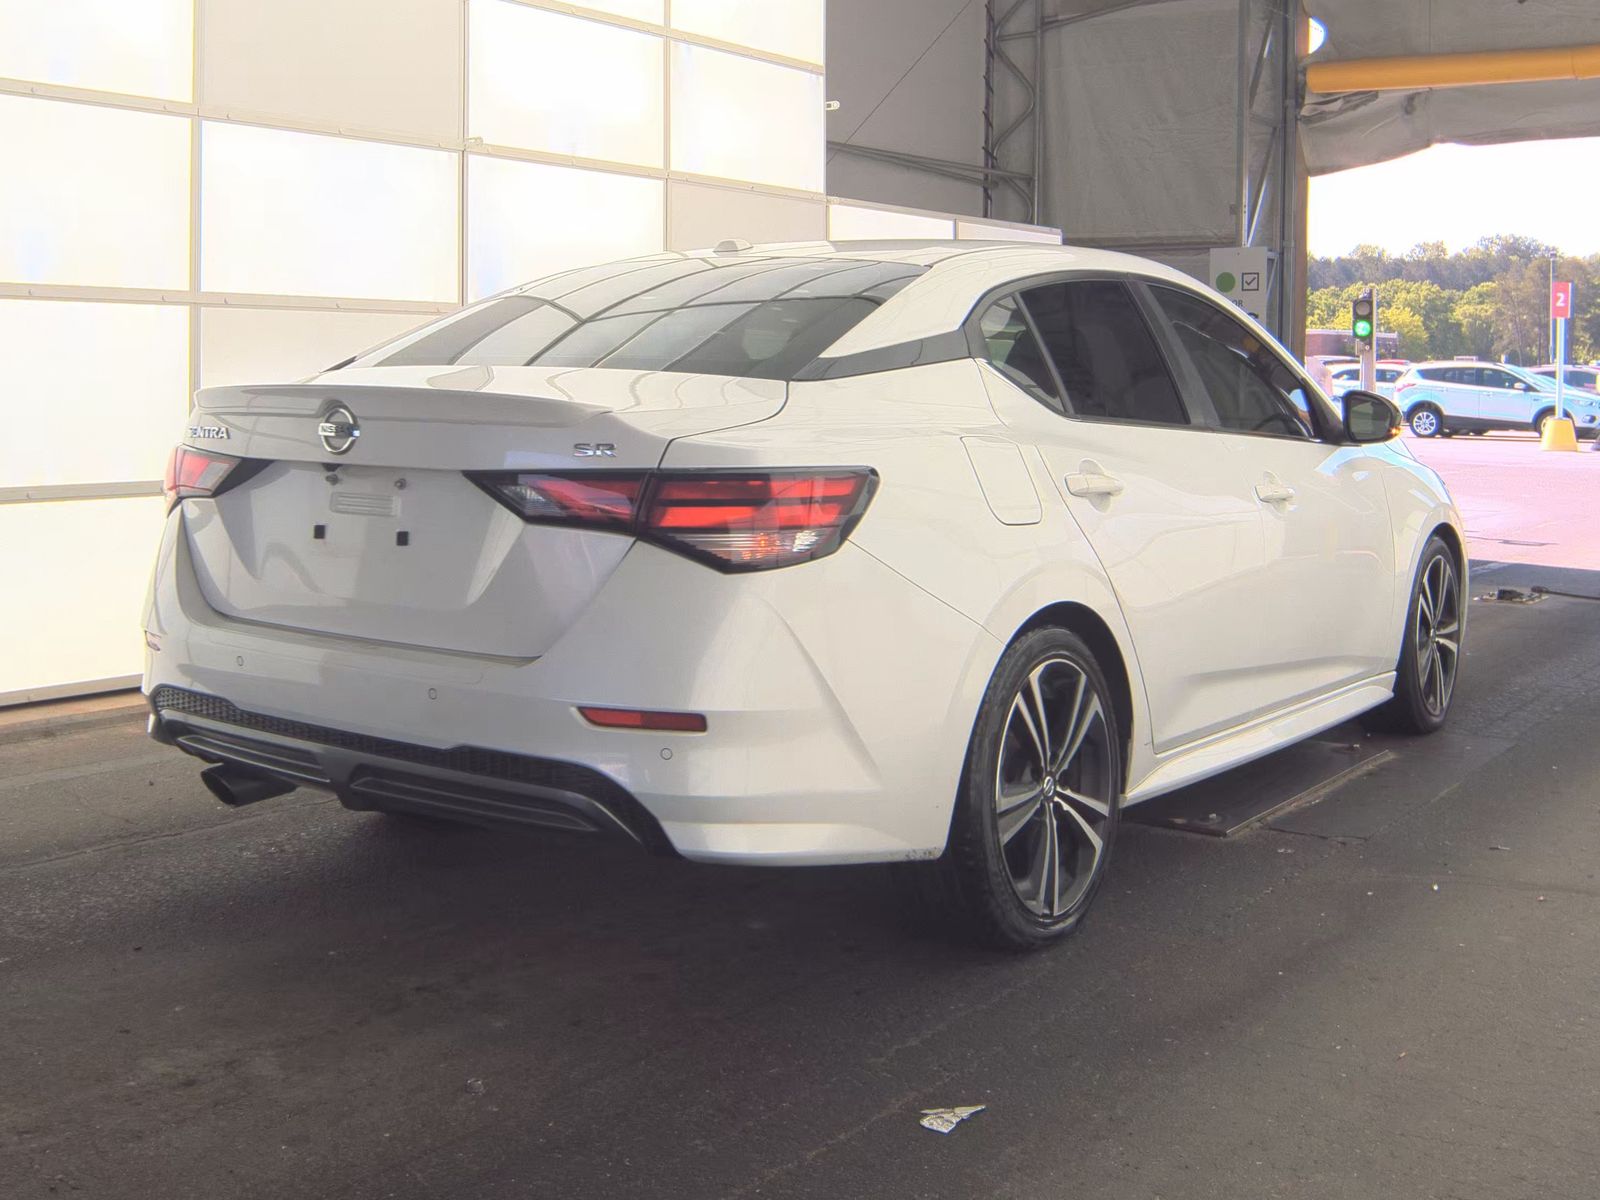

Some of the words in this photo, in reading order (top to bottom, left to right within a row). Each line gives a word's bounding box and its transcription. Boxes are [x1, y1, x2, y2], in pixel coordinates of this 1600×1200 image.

[1555, 292, 1565, 307] 2
[187, 425, 230, 439] ENTRA
[574, 443, 617, 457] SR
